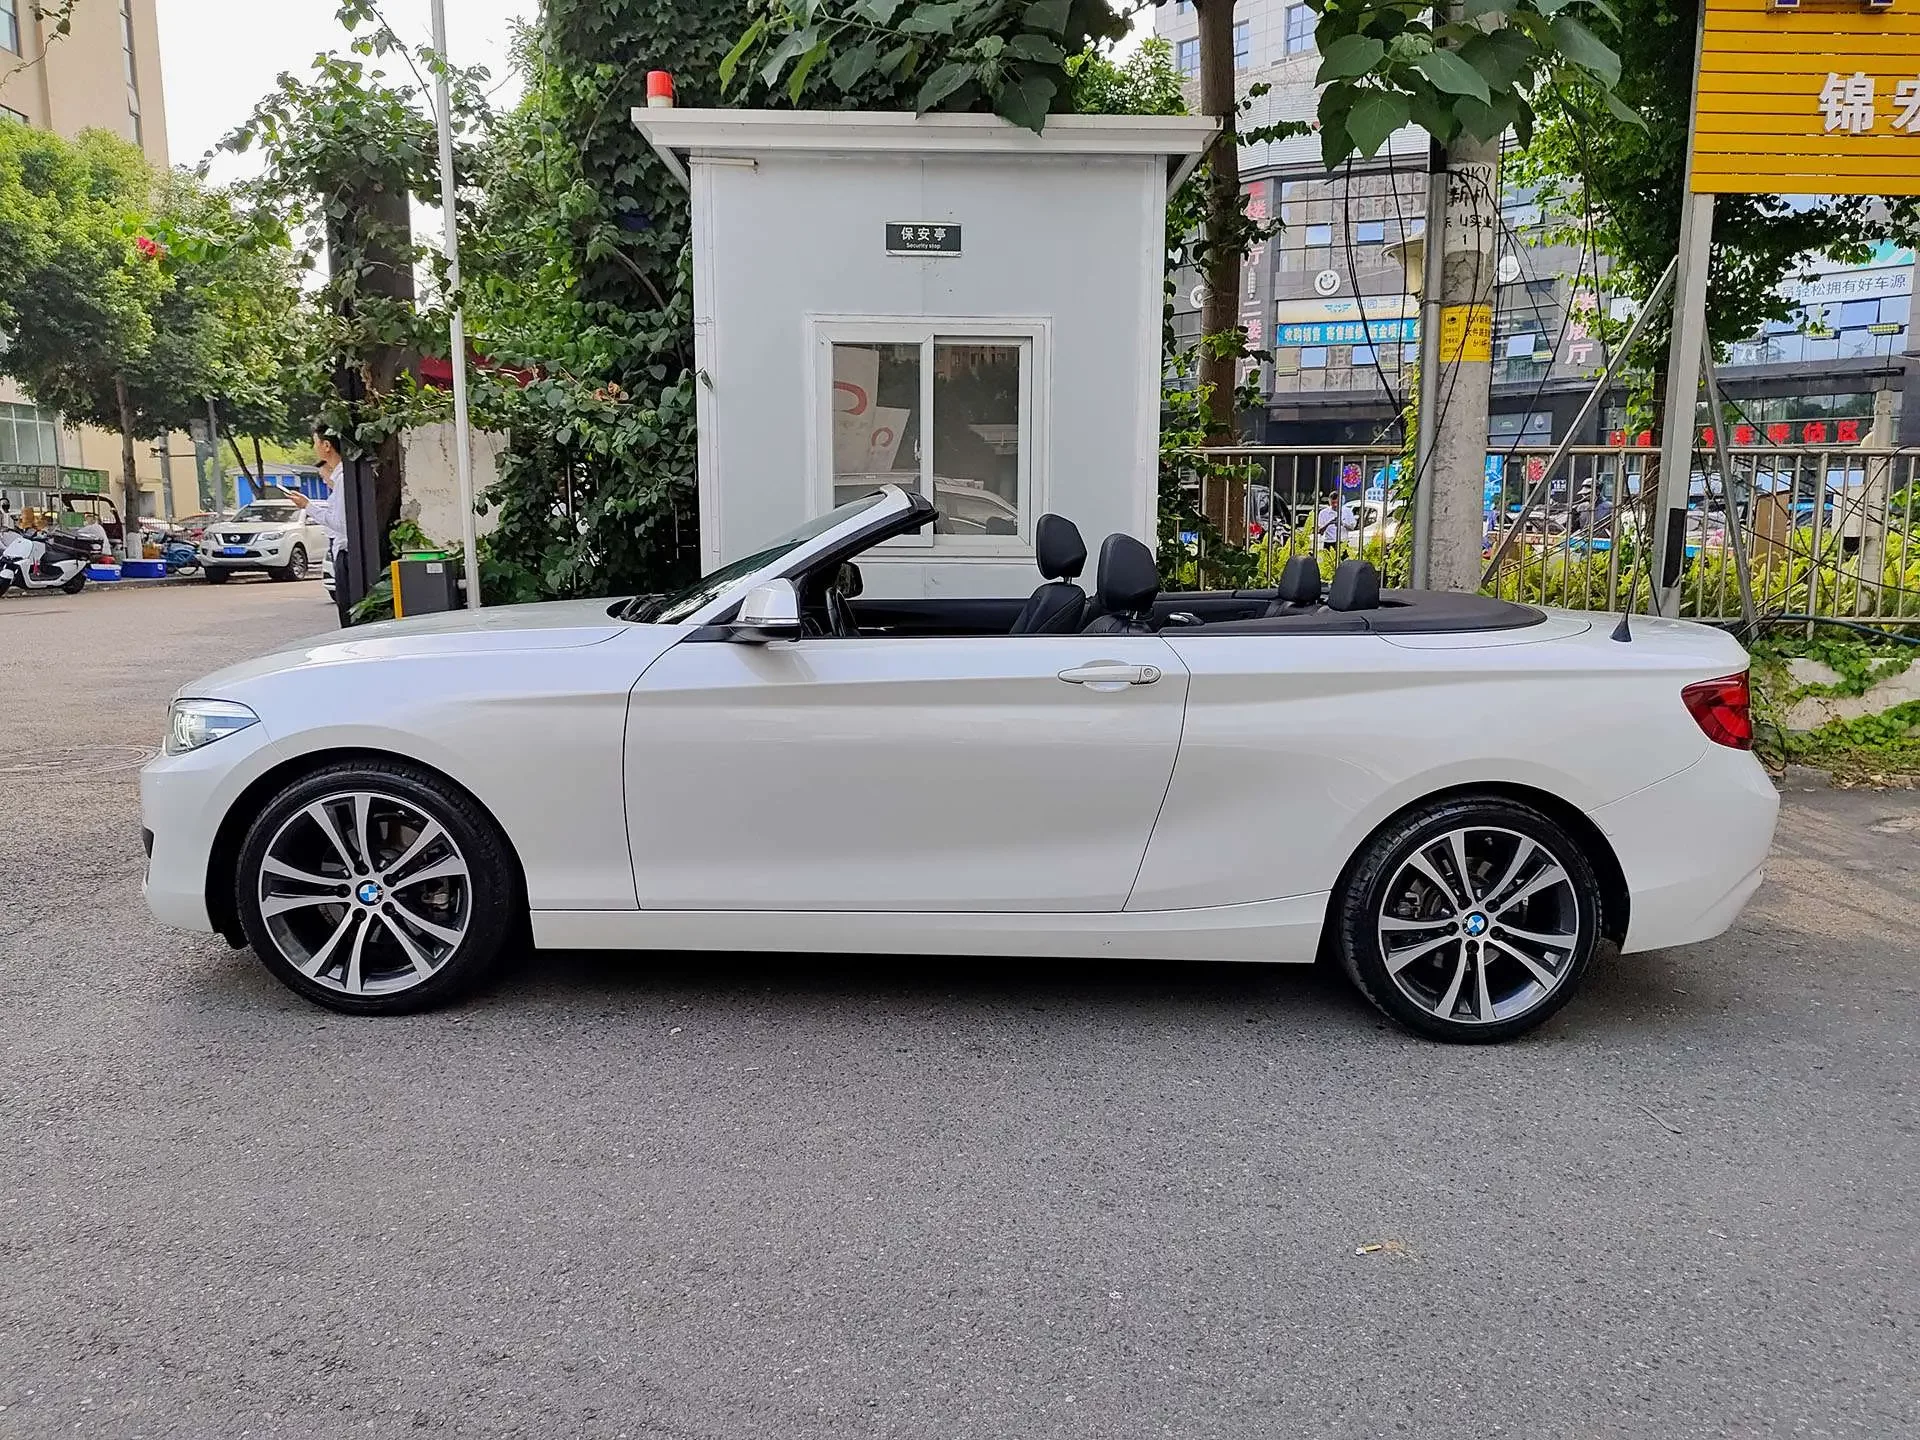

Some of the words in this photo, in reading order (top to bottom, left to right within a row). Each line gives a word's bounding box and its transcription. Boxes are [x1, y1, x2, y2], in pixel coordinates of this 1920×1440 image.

[901, 226, 946, 241] 保安亭
[905, 242, 928, 250] Security
